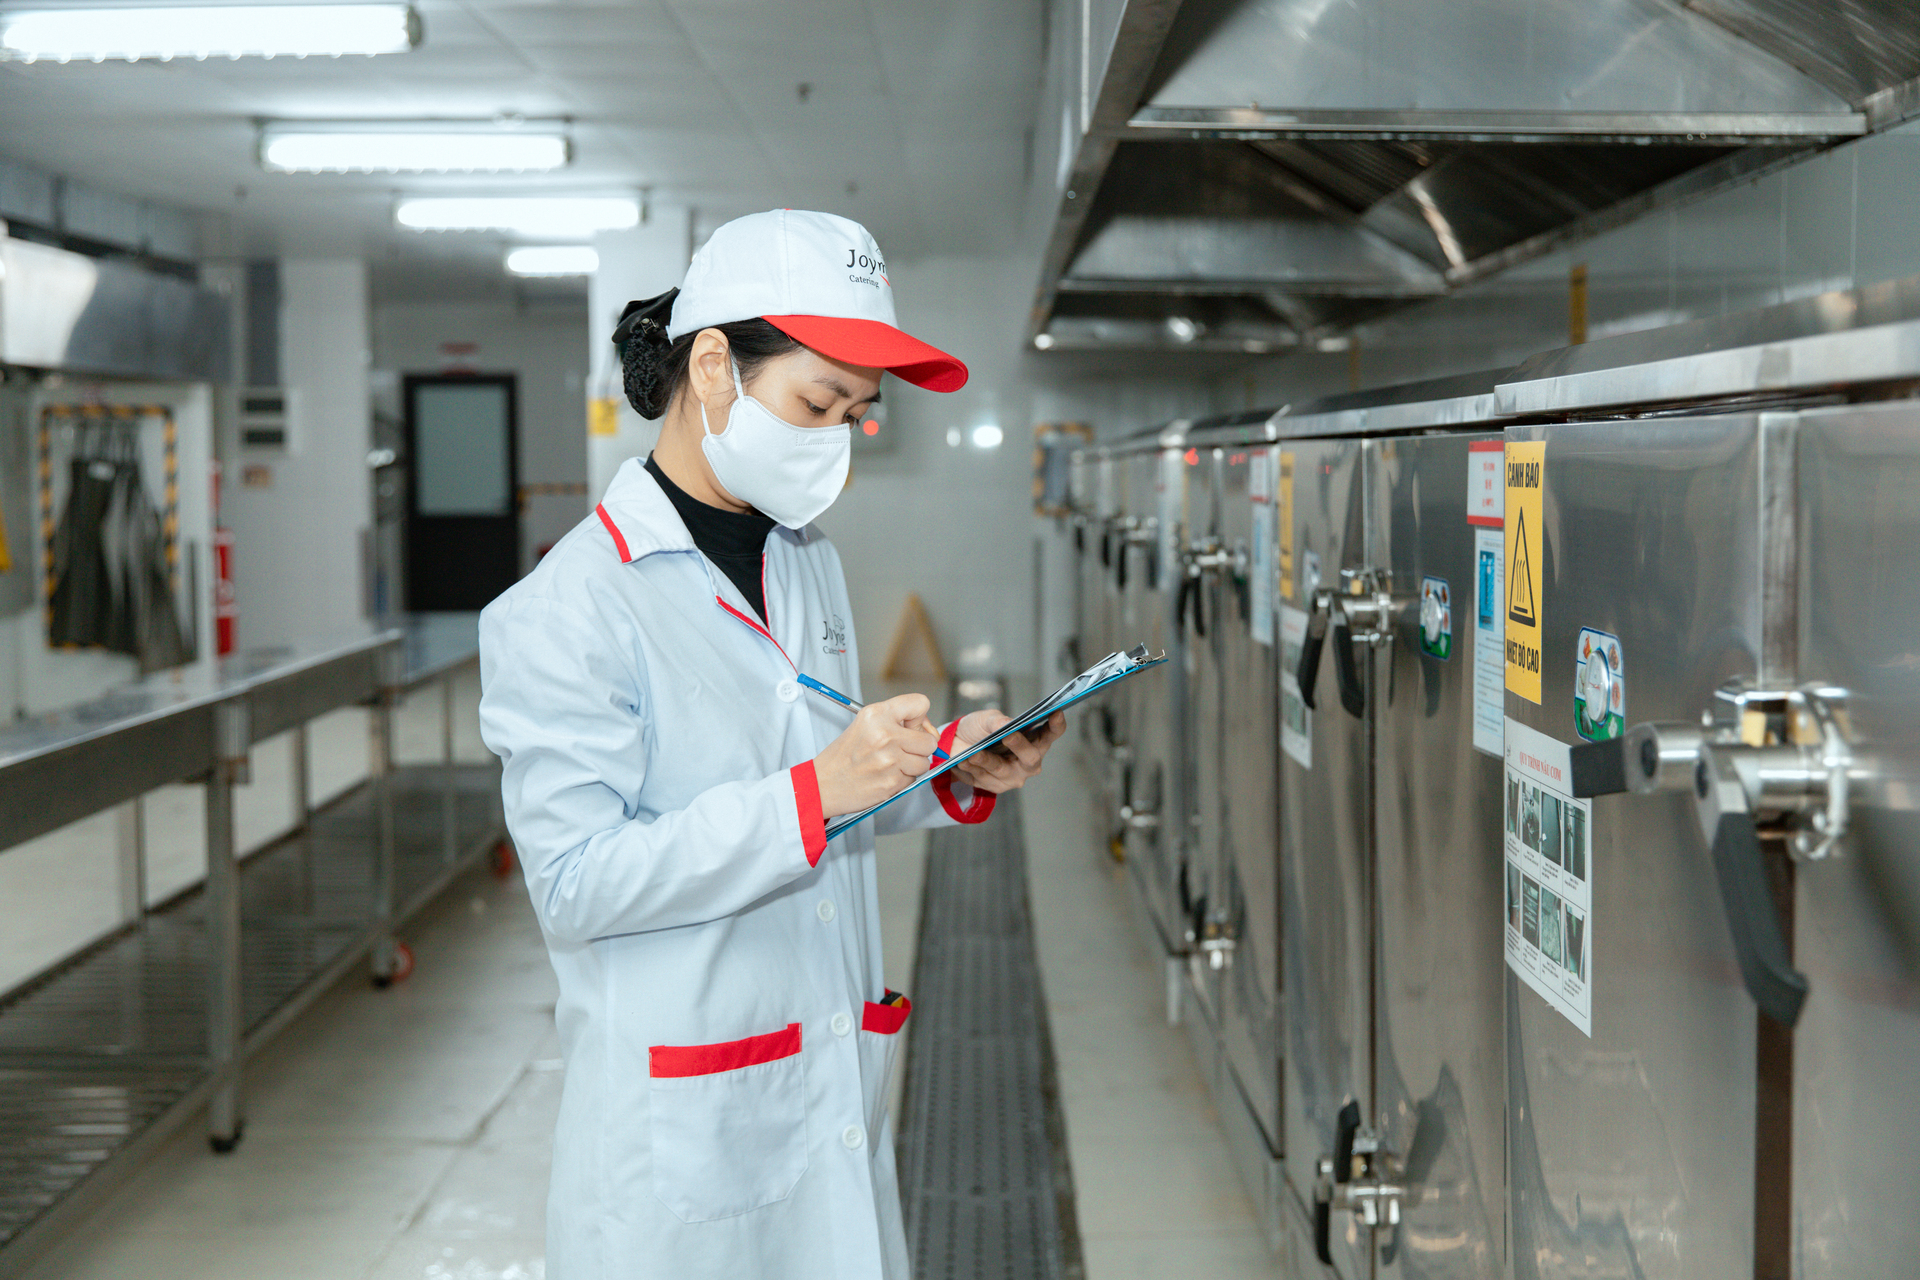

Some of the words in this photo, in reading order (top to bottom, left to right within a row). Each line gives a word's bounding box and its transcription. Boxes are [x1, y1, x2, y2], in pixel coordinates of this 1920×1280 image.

[849, 274, 880, 290] Catering
[1525, 457, 1540, 489] BÁO
[1526, 646, 1539, 674] CAO
